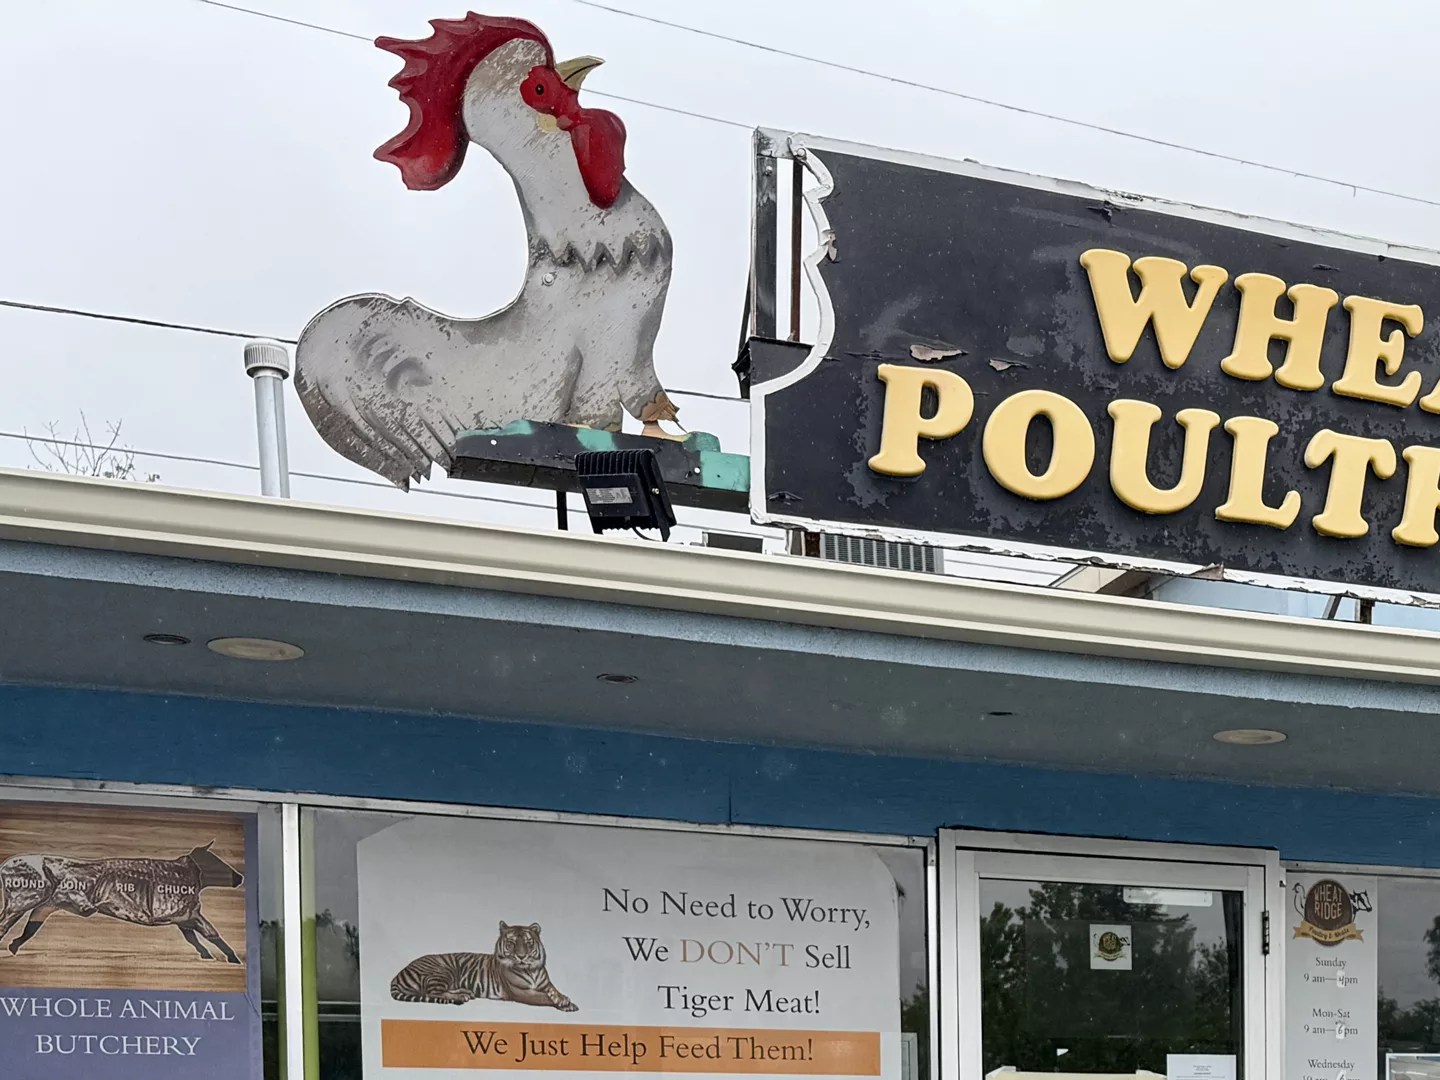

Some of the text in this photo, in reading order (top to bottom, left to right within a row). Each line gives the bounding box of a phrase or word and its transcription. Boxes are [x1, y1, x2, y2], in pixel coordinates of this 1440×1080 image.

[4, 878, 195, 895] ROUND LOIN RIB CHUCK
[1313, 884, 1343, 902] WHEAT
[602, 888, 870, 931] No Need to Worry,
[1314, 901, 1343, 920] RIDGE
[622, 937, 669, 962] We
[805, 945, 851, 969] Sell
[1315, 956, 1347, 970] Sunday
[1303, 972, 1310, 983] 9
[0, 997, 235, 1020] WHOLE ANIMAL
[657, 985, 819, 1018] Tiger Meat!
[1312, 1008, 1350, 1018] Mon-Sat
[1303, 1024, 1310, 1033] 9
[35, 1035, 201, 1056] BUTCHERY
[460, 1031, 812, 1065] We Just Help Feed Them!
[1307, 1059, 1355, 1072] Wednesday
